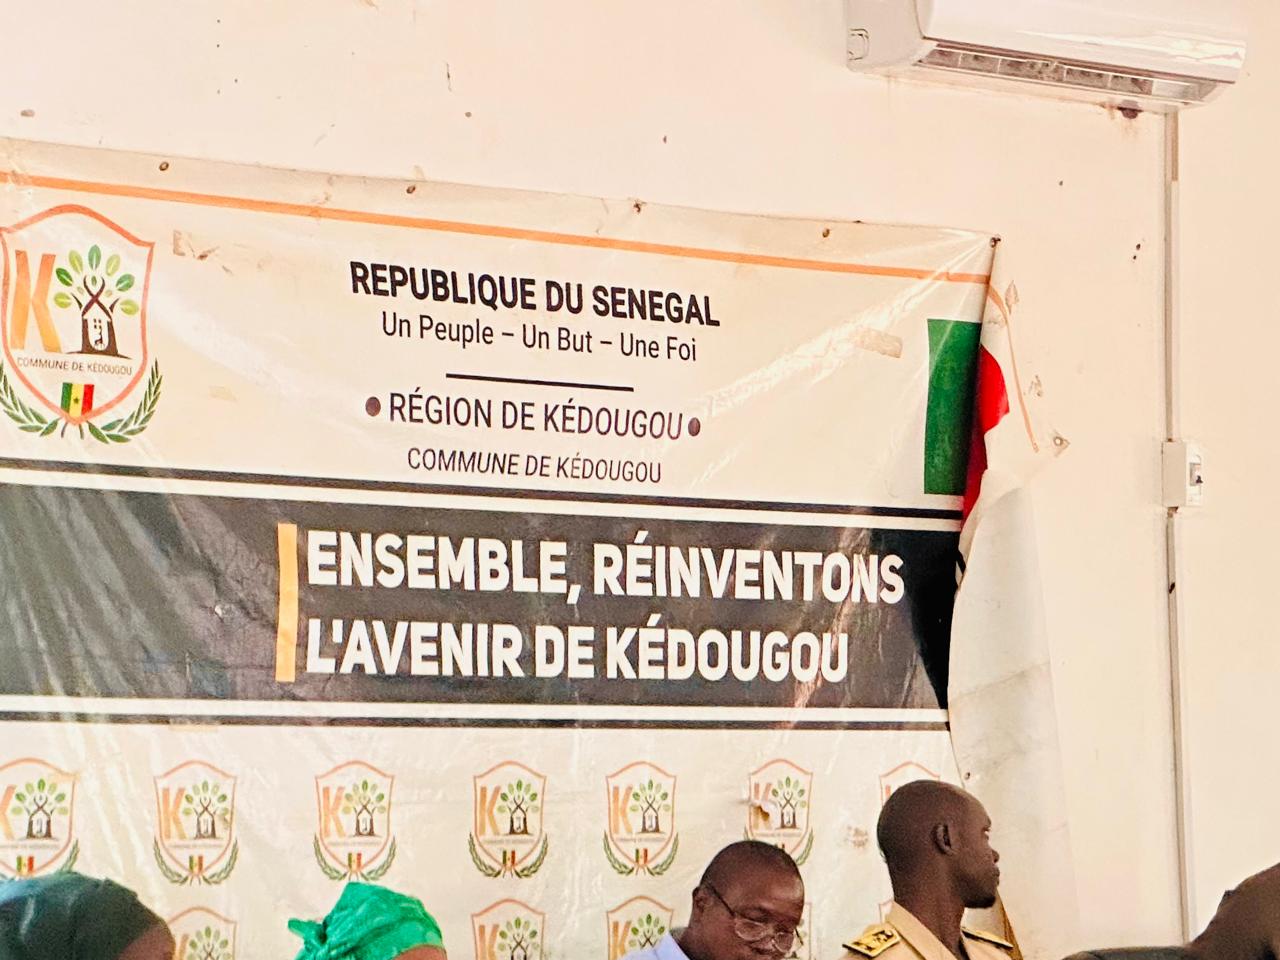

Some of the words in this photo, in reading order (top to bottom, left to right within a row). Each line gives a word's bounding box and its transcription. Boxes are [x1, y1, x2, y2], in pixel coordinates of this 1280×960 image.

[350, 261, 537, 311] REPUBLIQUE
[545, 280, 583, 315] DU
[592, 285, 721, 327] SENEGAL
[382, 310, 411, 338] Un
[419, 314, 494, 349] Peuple
[522, 323, 550, 350] Un
[558, 327, 593, 353] But
[620, 332, 660, 359] Une
[666, 336, 696, 361] Foi
[18, 357, 70, 371] COMMUNE
[72, 361, 83, 372] DE
[390, 386, 492, 428] RÉGION
[502, 400, 536, 431] DE
[543, 397, 683, 441] KÉDOUGOU
[407, 447, 520, 476] COMMUNE
[525, 454, 552, 478] DE
[556, 452, 662, 484] KÉDOUGOU
[307, 530, 582, 605] ENSEMBLE,
[593, 530, 905, 604] RÉINVENTONS
[306, 618, 526, 677] L'AVENIR
[534, 625, 595, 679] DE
[606, 613, 849, 684] KÉDOUGOU
